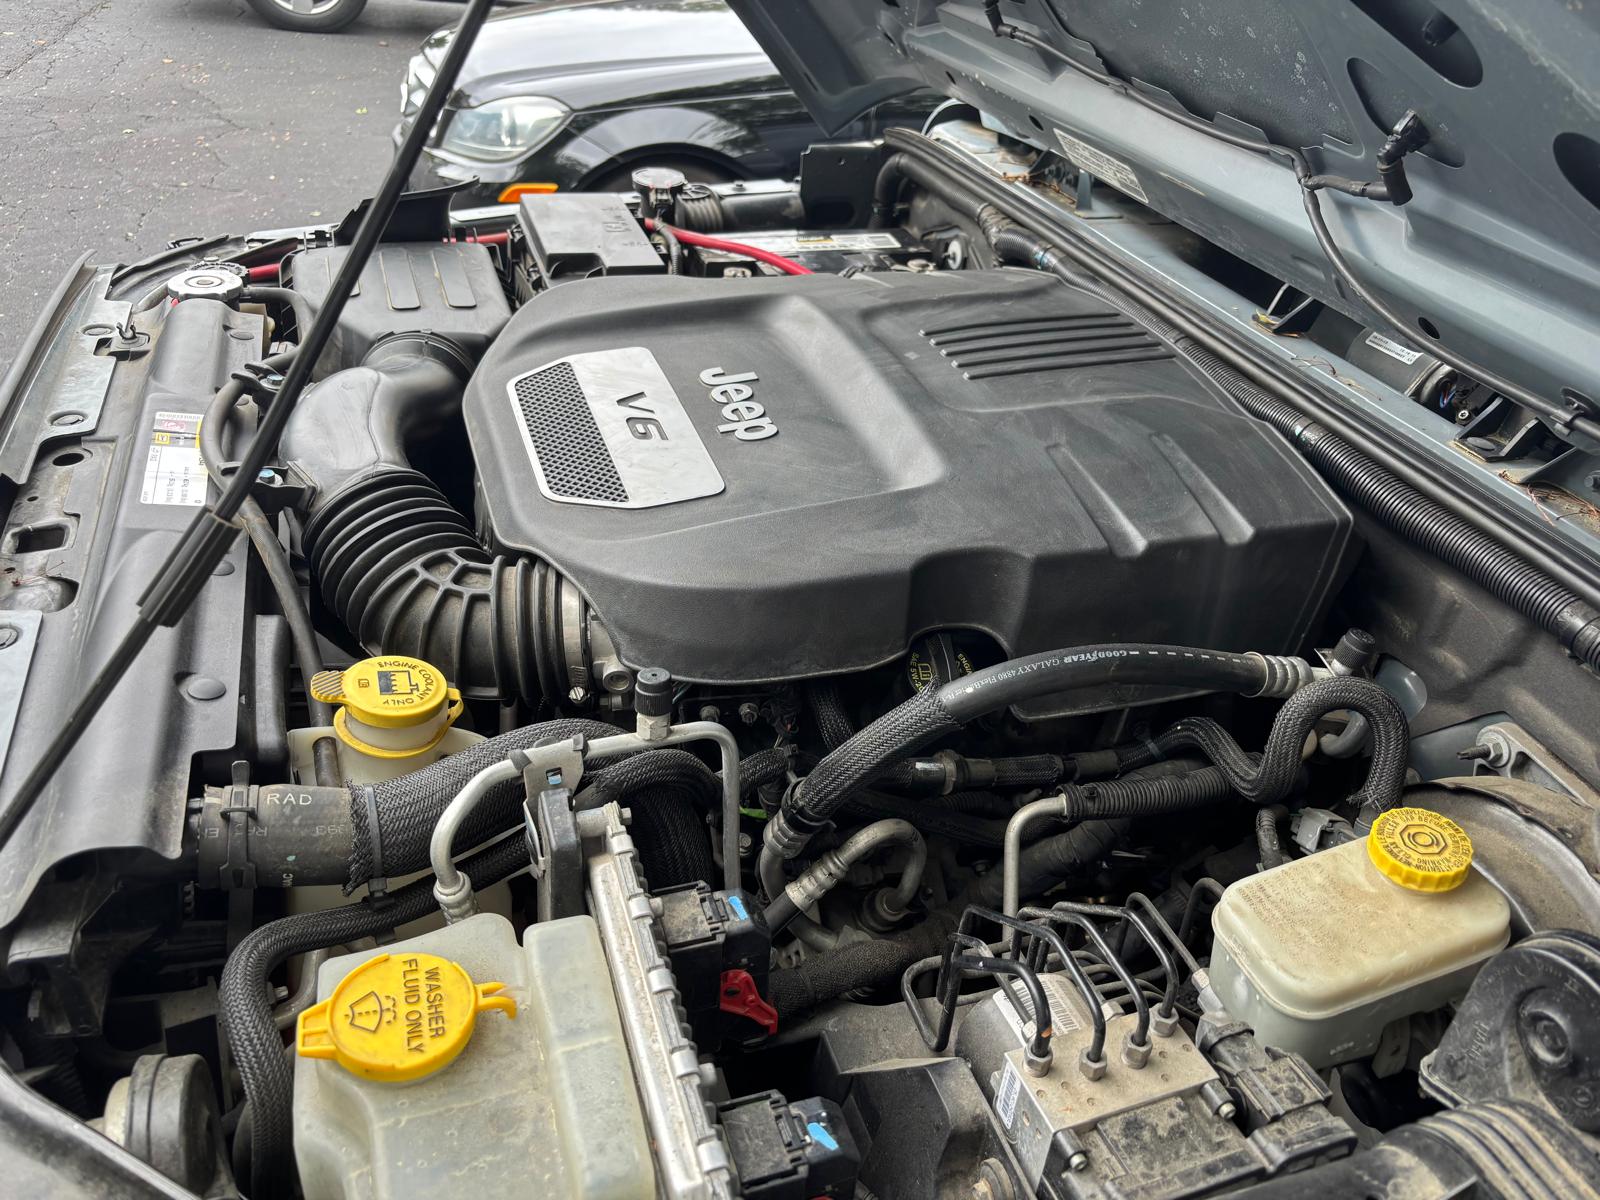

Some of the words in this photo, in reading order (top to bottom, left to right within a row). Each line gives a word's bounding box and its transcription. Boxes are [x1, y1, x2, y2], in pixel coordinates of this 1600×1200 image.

[616, 391, 669, 441] V6
[699, 367, 779, 441] Jeep
[377, 660, 420, 671] ENGINE
[1017, 658, 1060, 674] GALAXY
[1063, 649, 1127, 663] GOODYEAR
[383, 697, 415, 706] ONLY
[416, 668, 435, 702] COOLANT
[266, 793, 313, 805] RAD
[402, 958, 421, 1005] FLUID
[424, 966, 446, 1039] WASHER
[405, 1009, 425, 1053] ONLY
